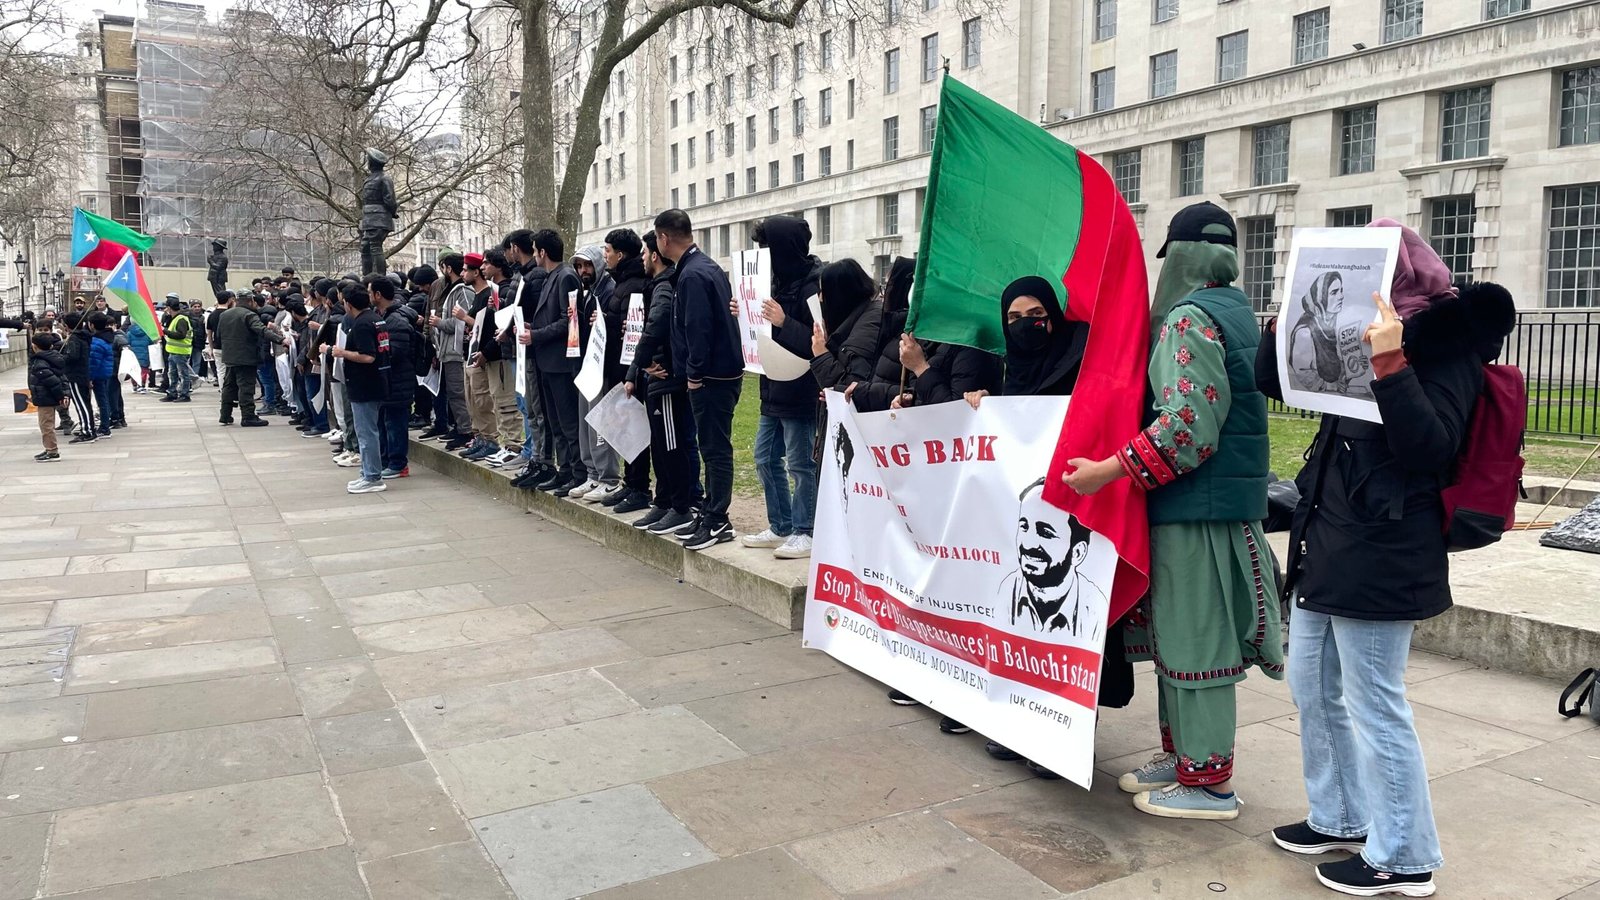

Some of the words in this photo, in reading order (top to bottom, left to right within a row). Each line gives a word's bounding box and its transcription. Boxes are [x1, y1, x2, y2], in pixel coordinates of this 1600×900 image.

[866, 442, 911, 468] NG
[923, 435, 998, 465] BACK
[853, 482, 883, 498] ASAD
[939, 545, 1001, 566] BALOCH
[863, 567, 885, 582] END
[928, 597, 995, 618] INJUSTICE!
[822, 571, 852, 603] Stop
[986, 633, 999, 663] in
[1001, 640, 1097, 694] Balochistan
[841, 616, 879, 643] BALOCH
[931, 656, 990, 695] MOVEMENT
